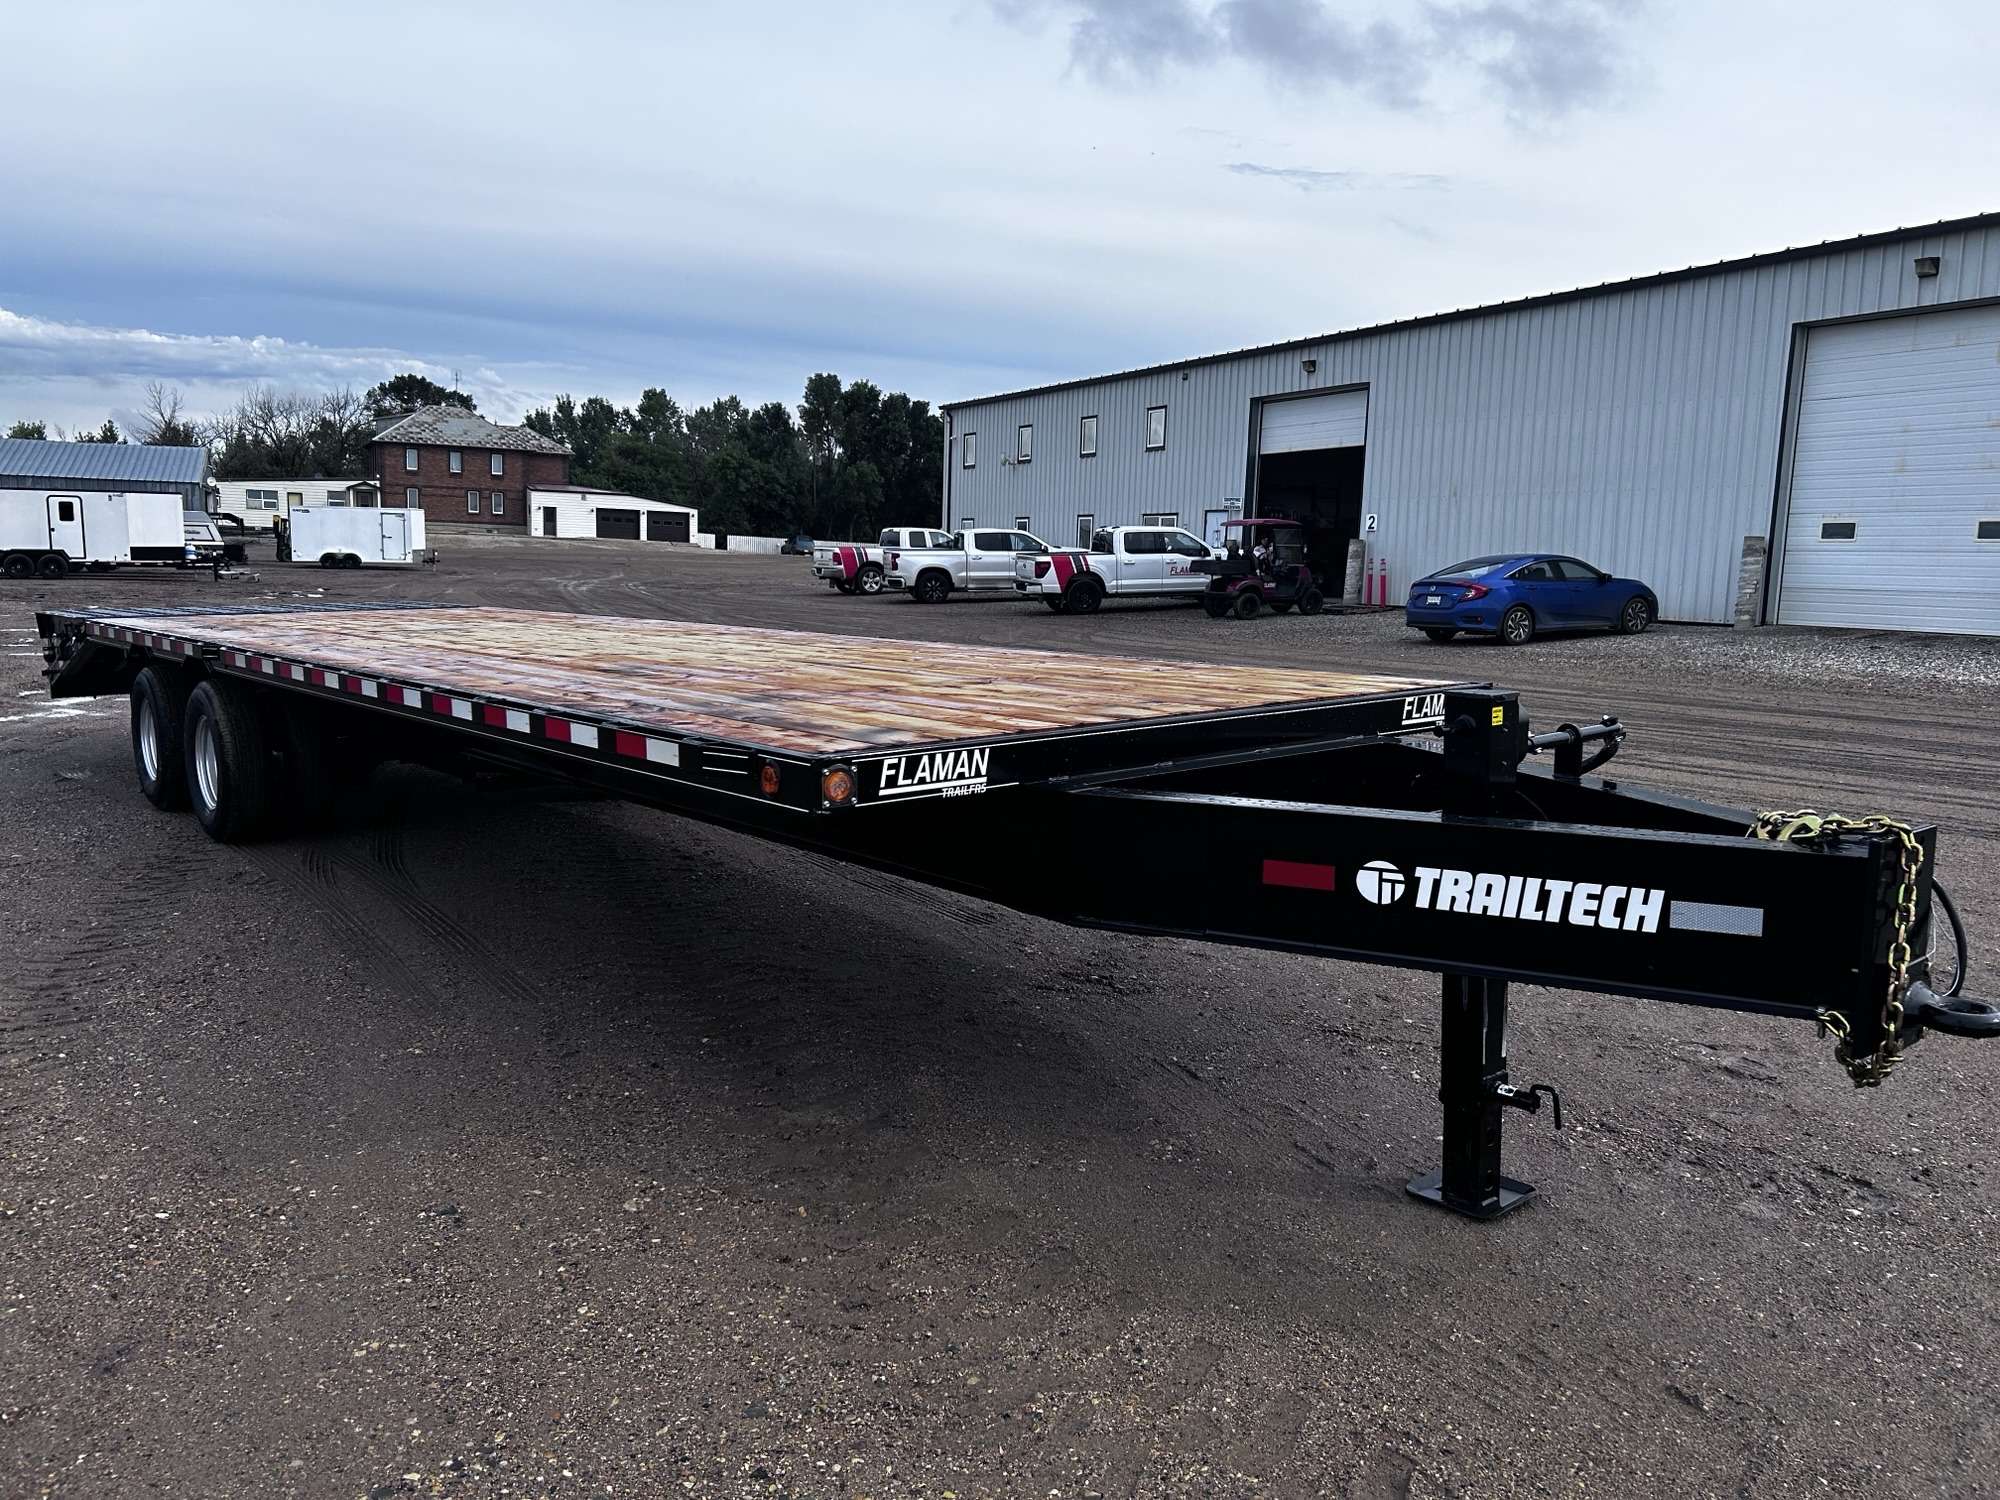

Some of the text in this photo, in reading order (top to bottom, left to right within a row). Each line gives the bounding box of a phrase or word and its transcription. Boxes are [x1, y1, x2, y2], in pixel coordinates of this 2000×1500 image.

[1367, 515, 1376, 530] 2
[1402, 693, 1446, 719] FLAM
[879, 748, 990, 788] FLAMAN
[1414, 866, 1665, 933] TRAILTECH
